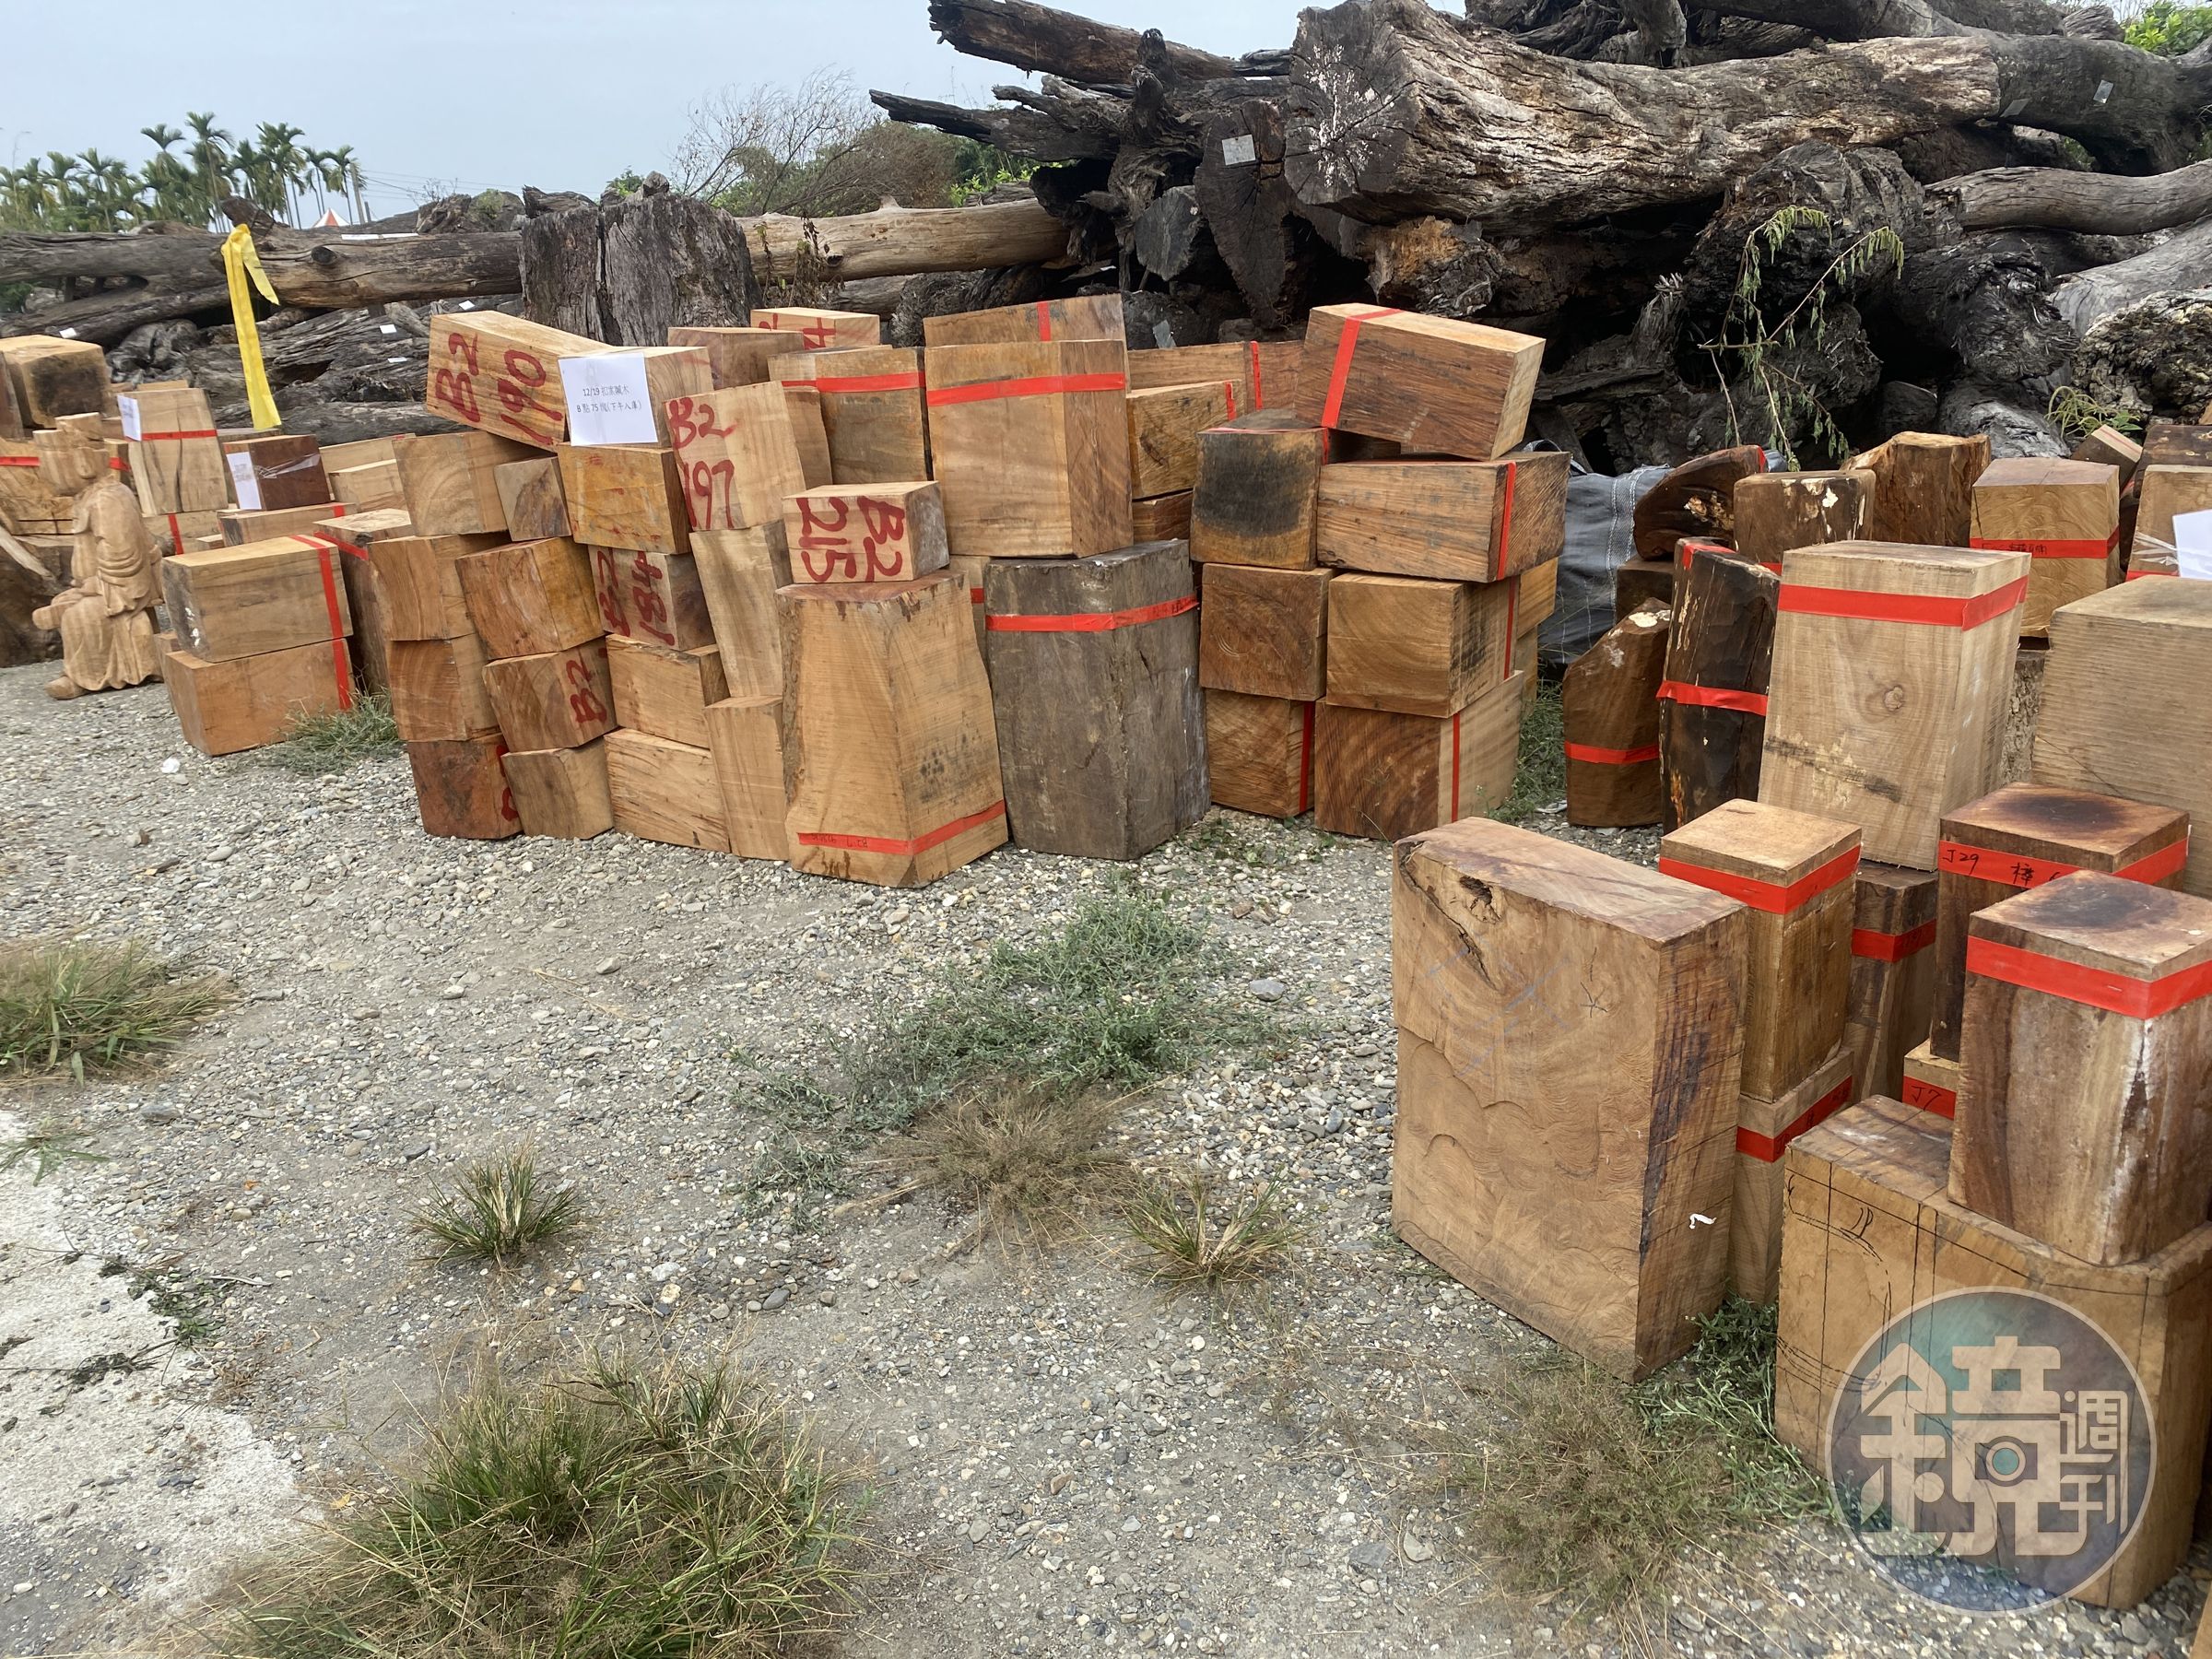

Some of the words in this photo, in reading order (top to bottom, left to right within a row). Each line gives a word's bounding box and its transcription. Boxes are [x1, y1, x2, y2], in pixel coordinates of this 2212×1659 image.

[435, 333, 480, 423] B2
[497, 349, 563, 446] 190
[669, 397, 736, 449] B2
[680, 459, 735, 530] 197
[796, 497, 857, 582] 215
[857, 495, 905, 582] B2
[565, 659, 607, 724] B2
[1942, 849, 1980, 876] J29
